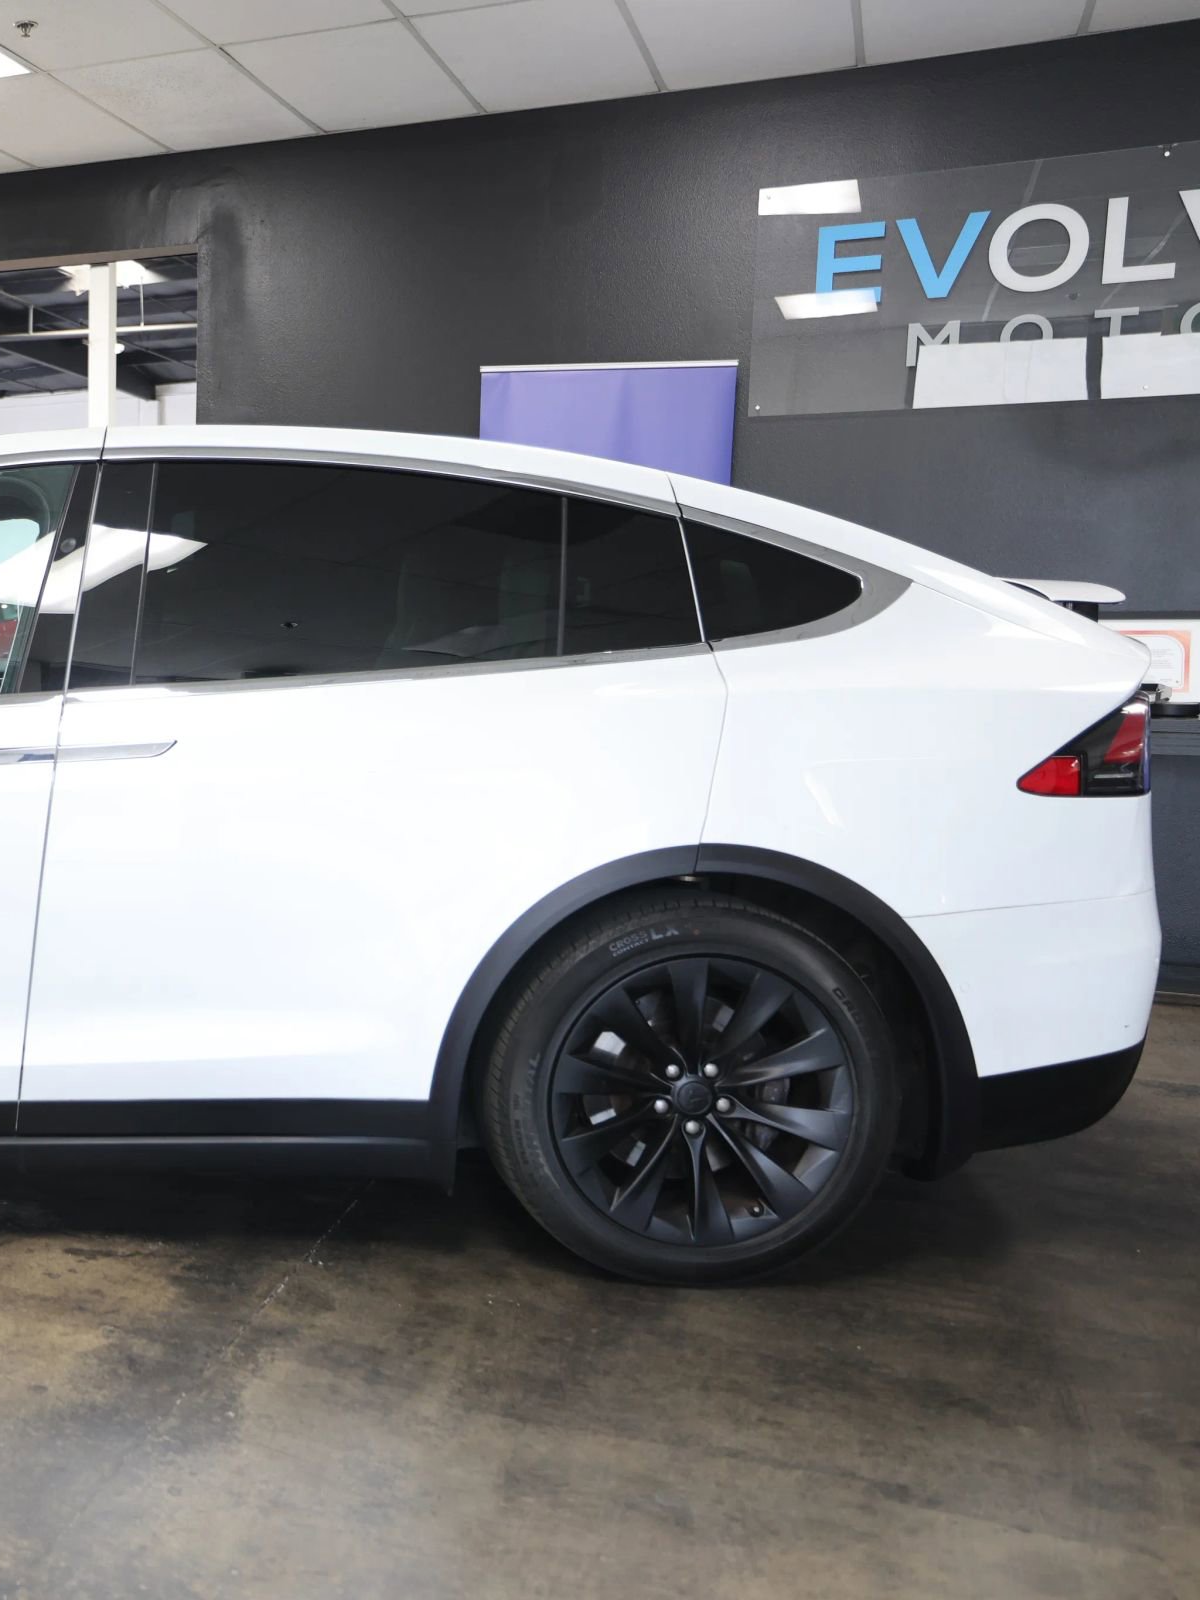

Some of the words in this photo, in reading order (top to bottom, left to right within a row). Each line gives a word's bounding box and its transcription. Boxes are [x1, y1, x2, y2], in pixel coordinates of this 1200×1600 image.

[814, 188, 1200, 304] EVOL
[906, 302, 1200, 367] MOT
[608, 930, 648, 952] CROSS
